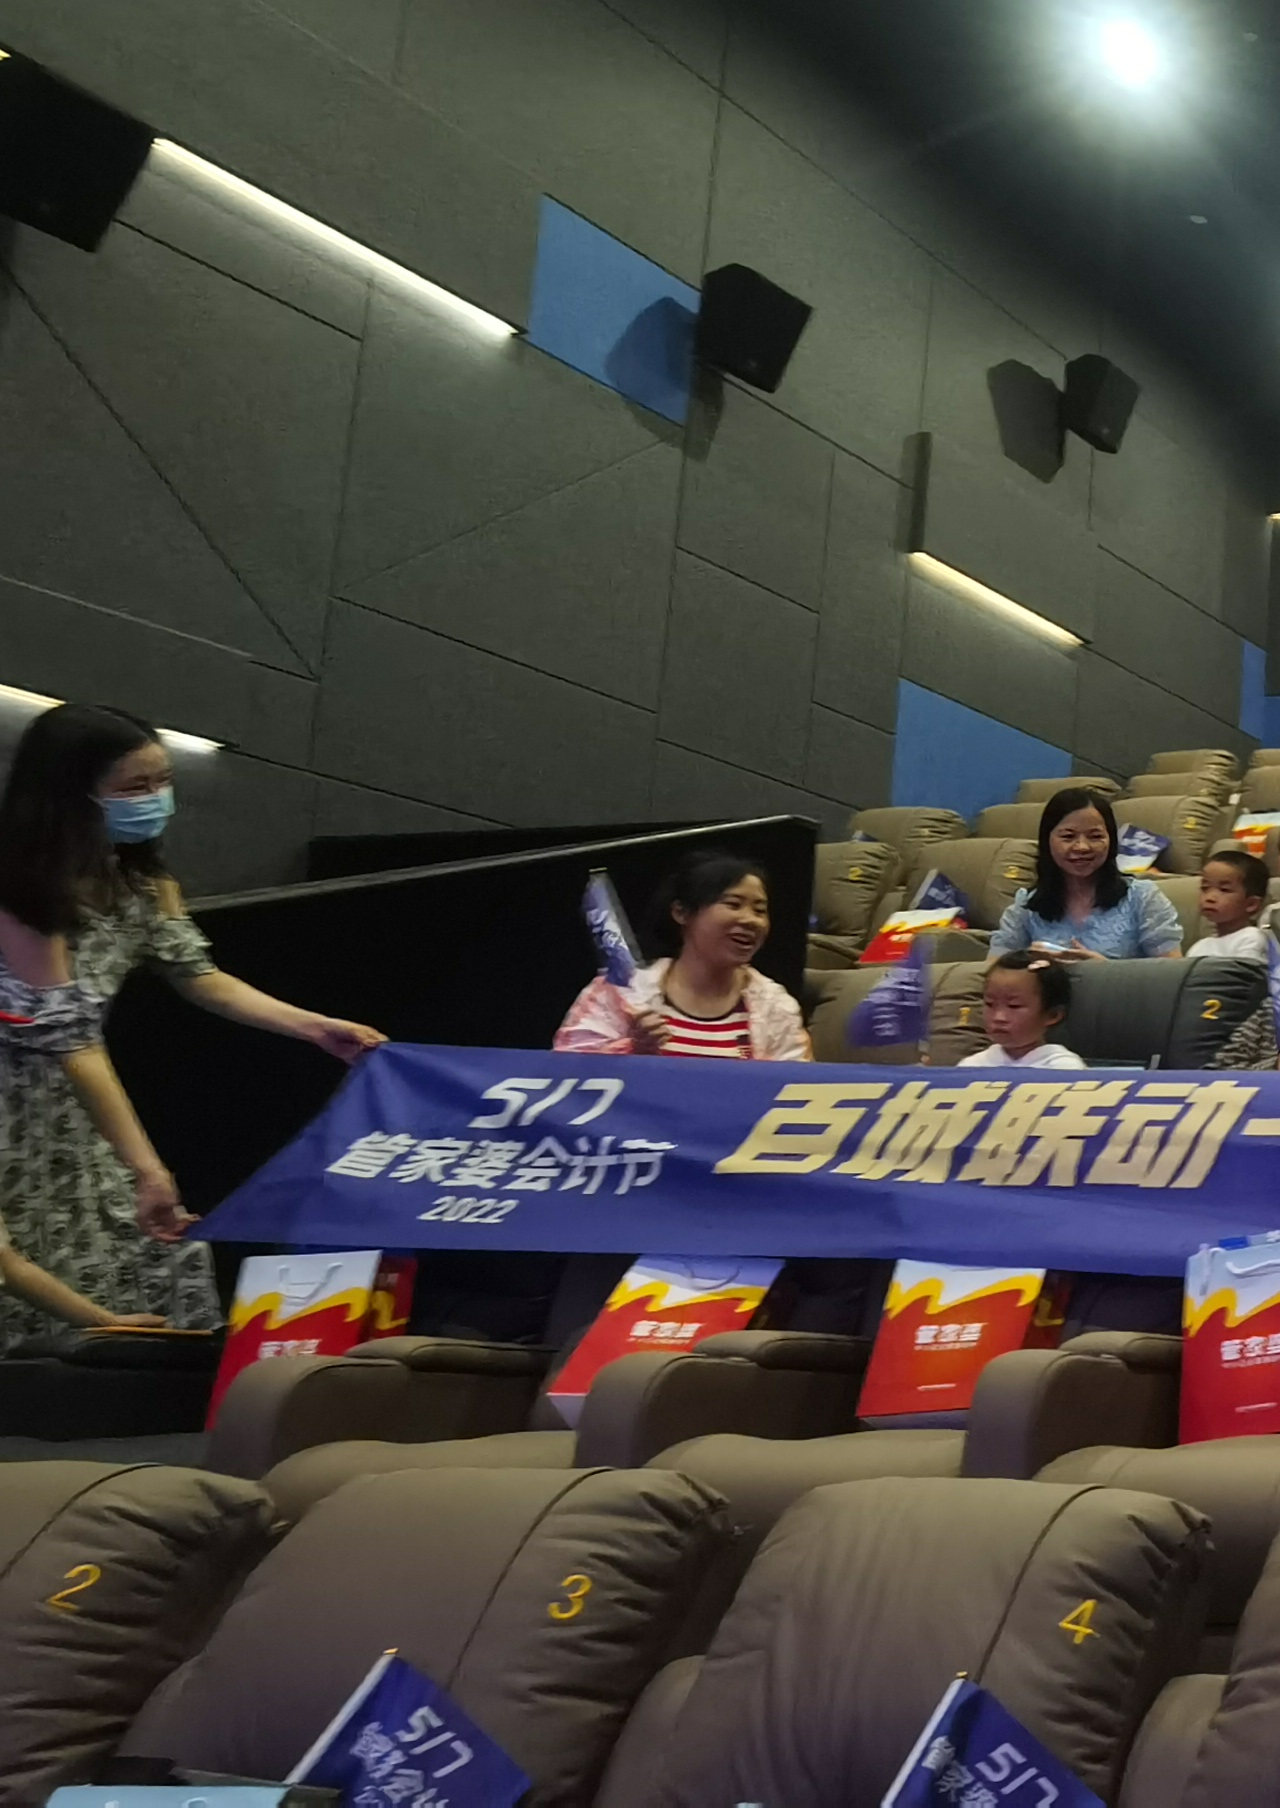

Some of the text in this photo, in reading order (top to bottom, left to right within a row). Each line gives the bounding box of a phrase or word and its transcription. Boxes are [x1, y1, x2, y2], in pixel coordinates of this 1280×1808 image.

[1203, 998, 1221, 1020] 2
[467, 1077, 625, 1129] 517
[325, 1131, 679, 1195] 管家婆会计节
[416, 1196, 519, 1223] 2022
[45, 1564, 100, 1608] 2
[547, 1575, 593, 1619] 3
[1058, 1599, 1099, 1644] 4
[394, 1704, 475, 1780] 517
